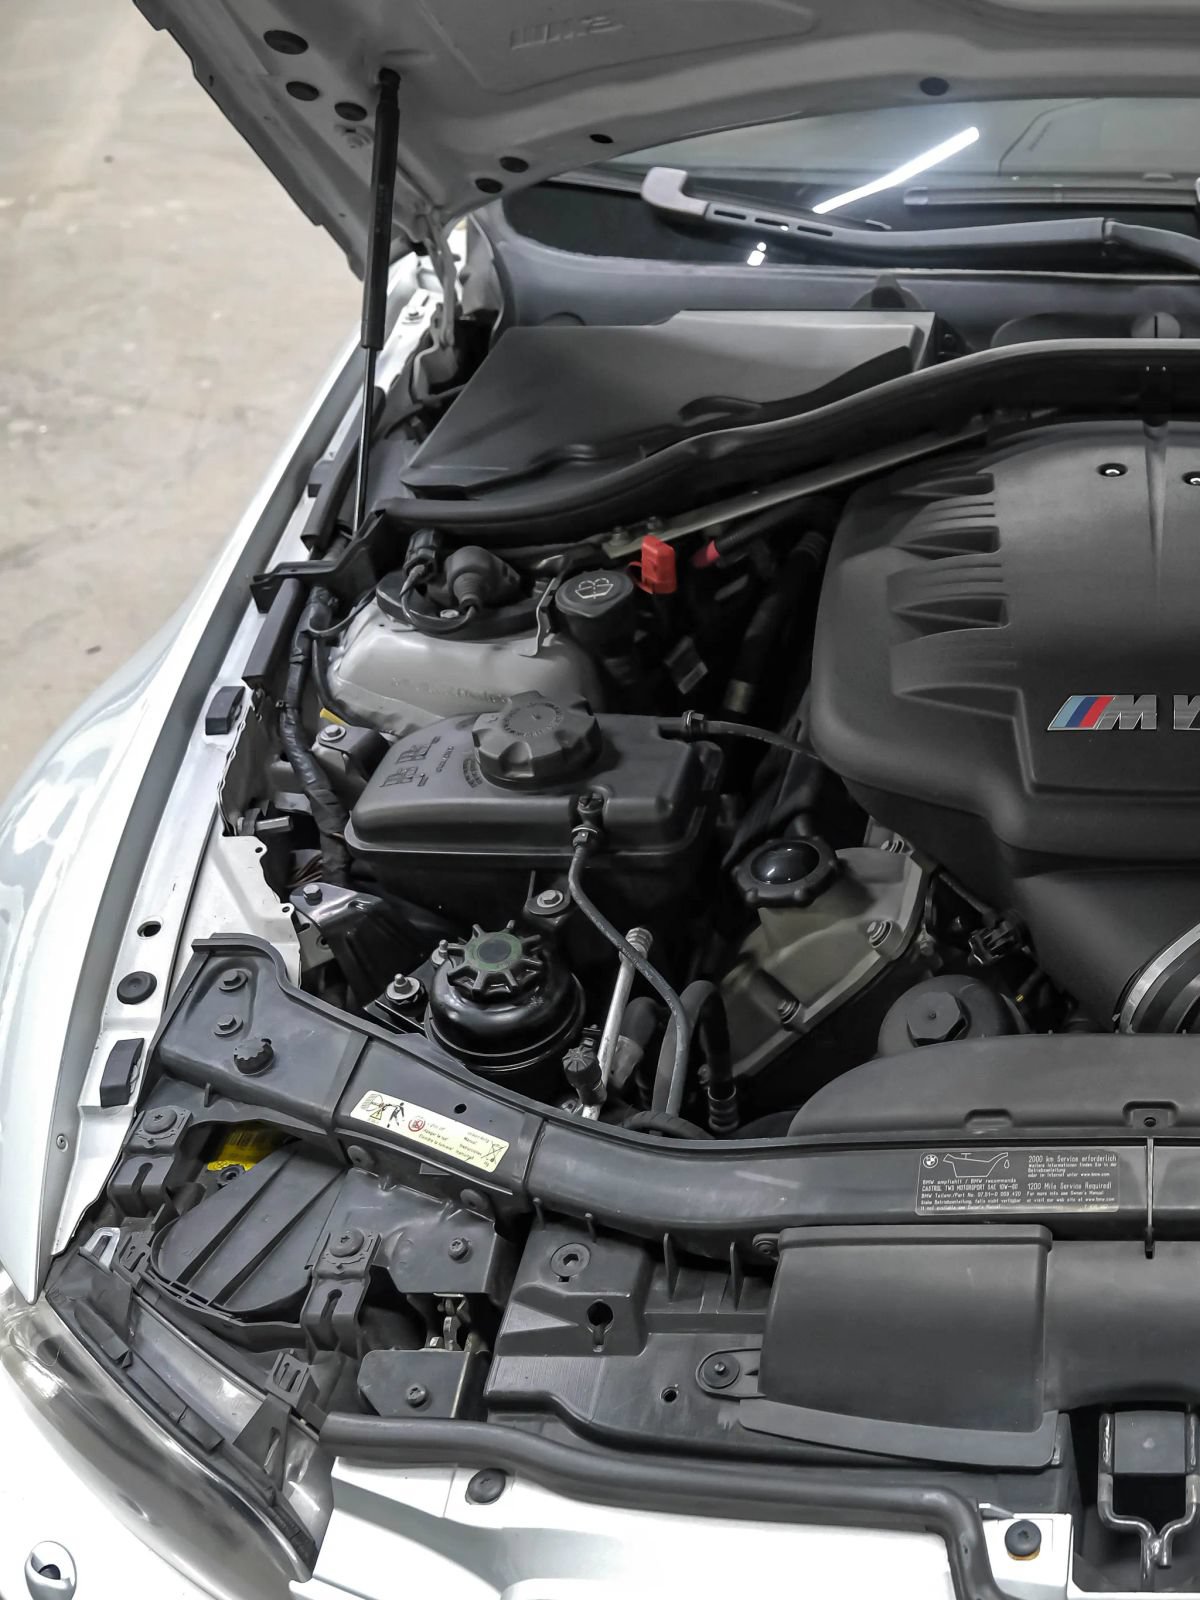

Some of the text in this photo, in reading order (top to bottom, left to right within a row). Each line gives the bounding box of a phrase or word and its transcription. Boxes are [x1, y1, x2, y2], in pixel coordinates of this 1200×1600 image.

[1028, 1154, 1117, 1163] 2000 km Service erforderlich
[1027, 1182, 1042, 1190] 1200
[1044, 1182, 1057, 1190] Mile
[1059, 1181, 1082, 1190] Service
